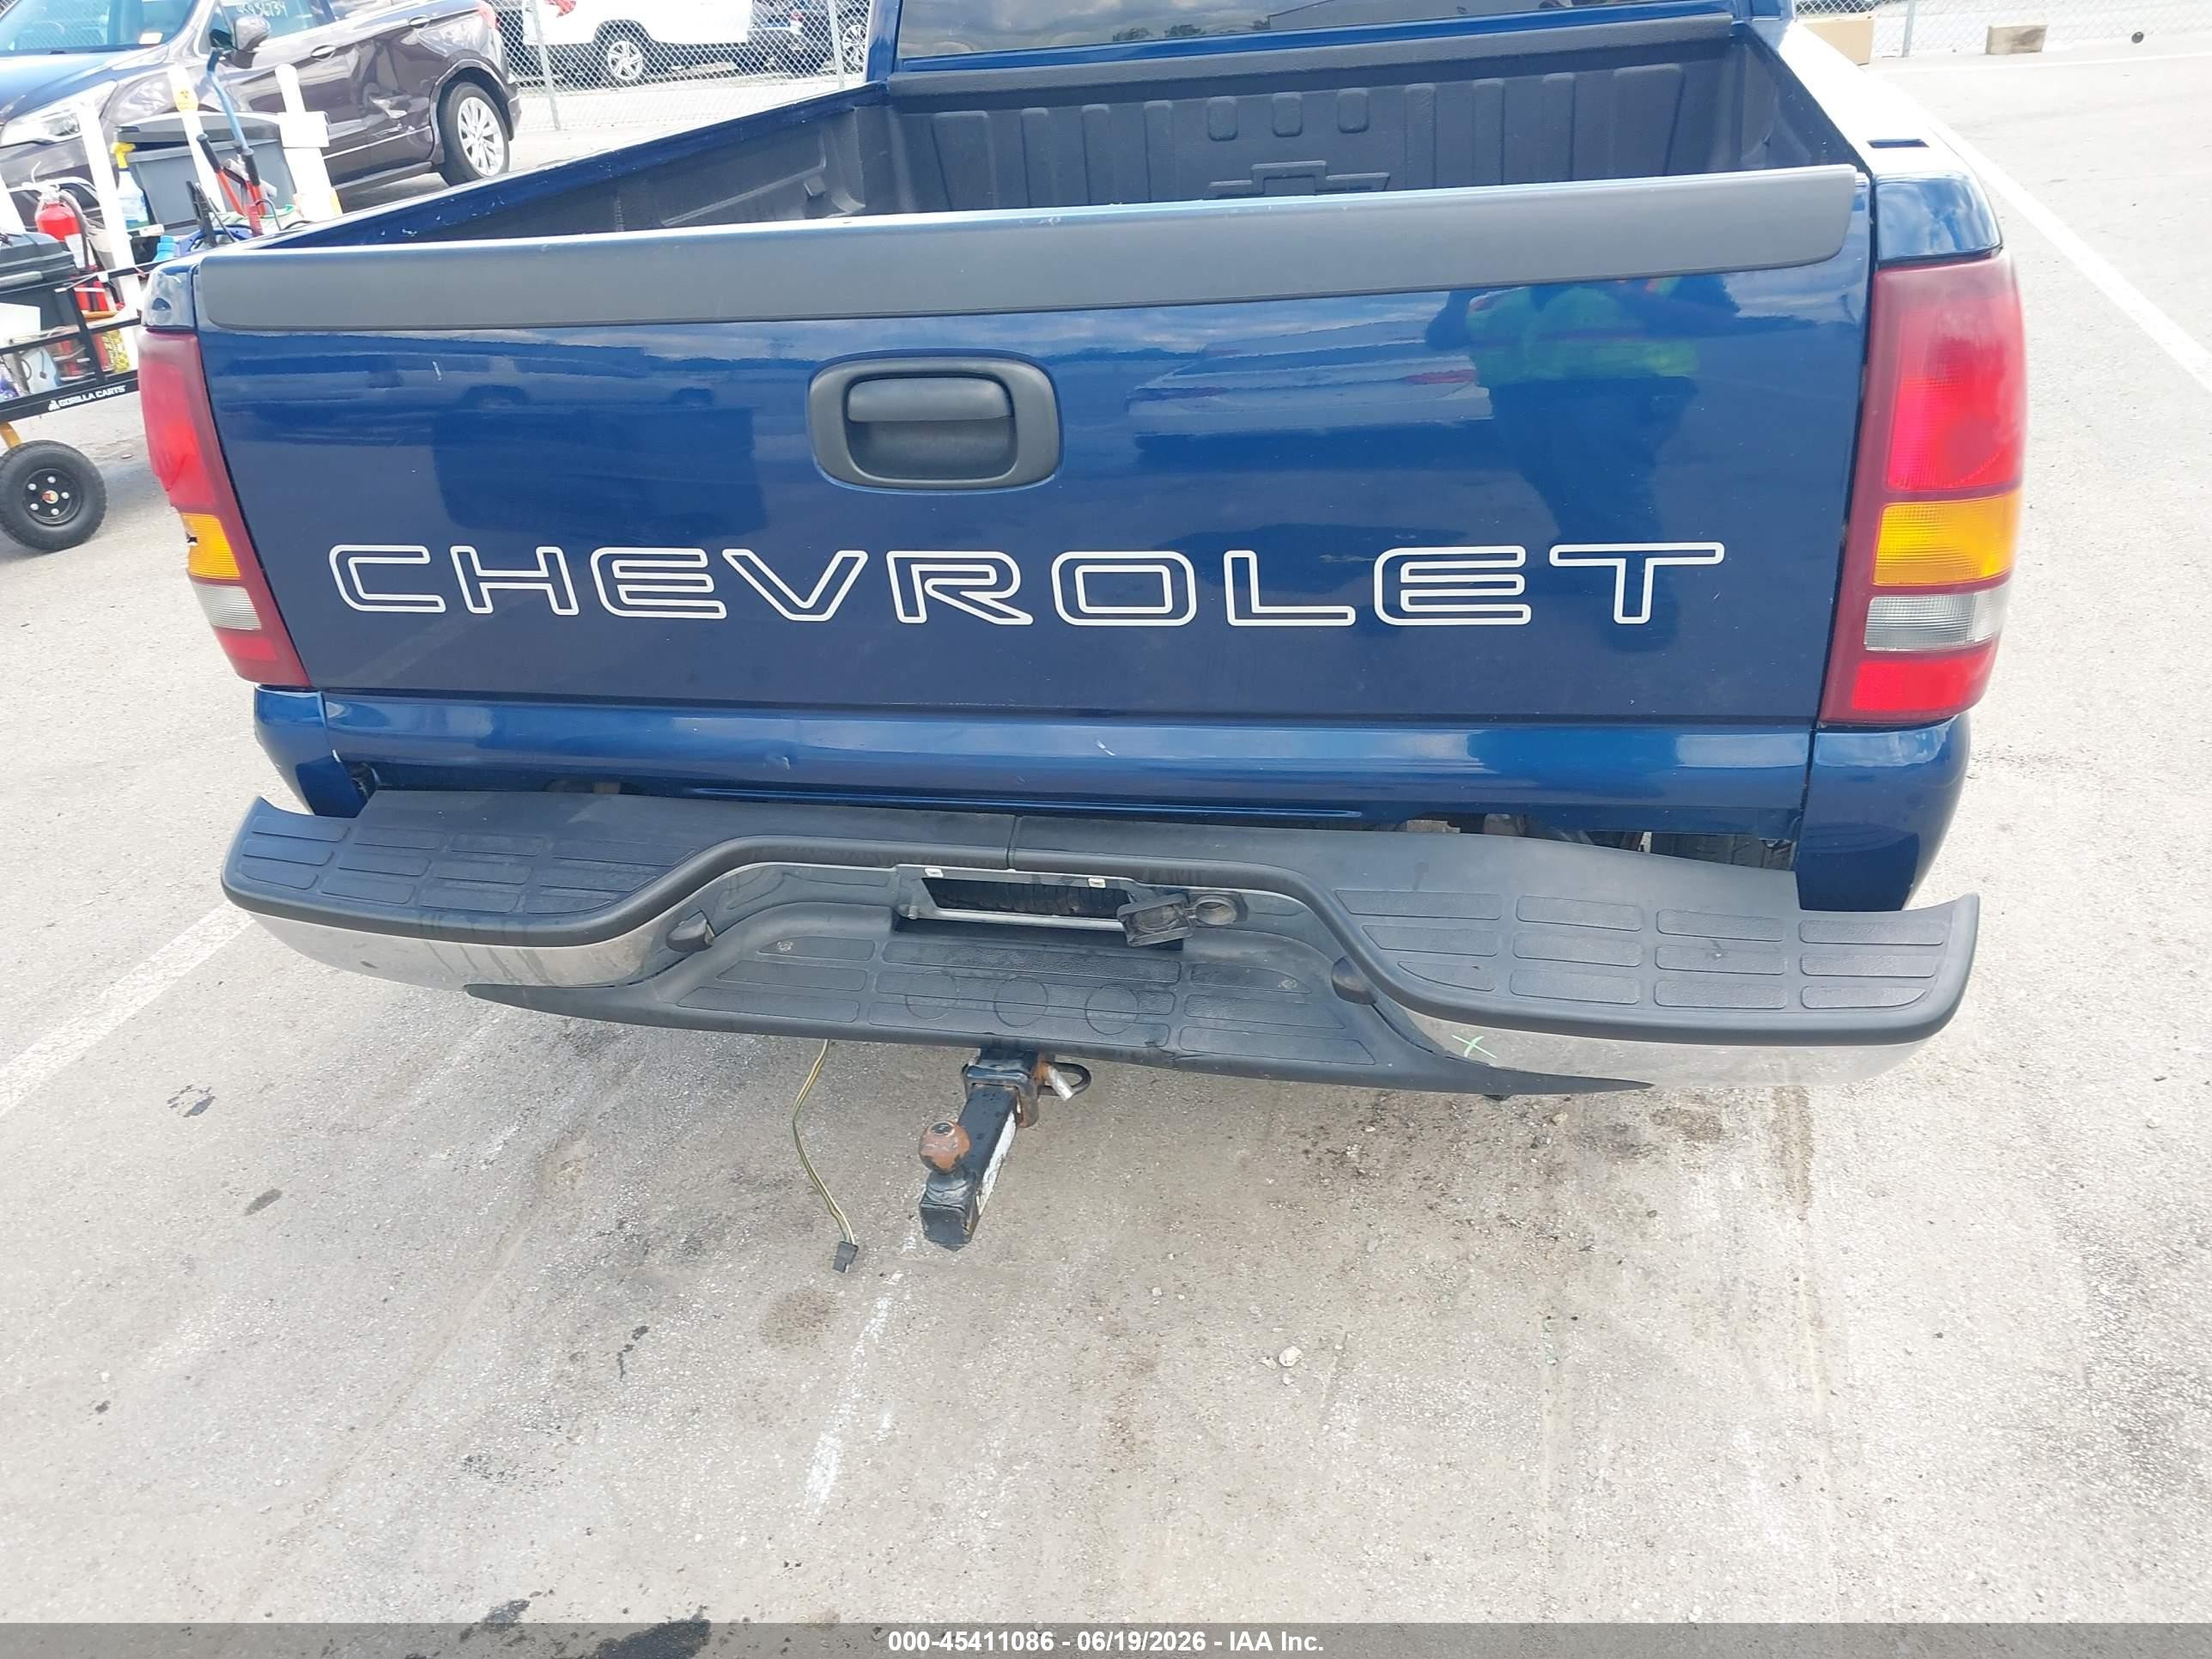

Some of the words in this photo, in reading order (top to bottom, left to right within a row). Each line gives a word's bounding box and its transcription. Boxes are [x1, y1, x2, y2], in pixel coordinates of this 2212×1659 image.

[58, 392, 95, 406] GORILLA
[95, 386, 125, 398] CARTS
[328, 542, 1725, 627] CHEVROLET
